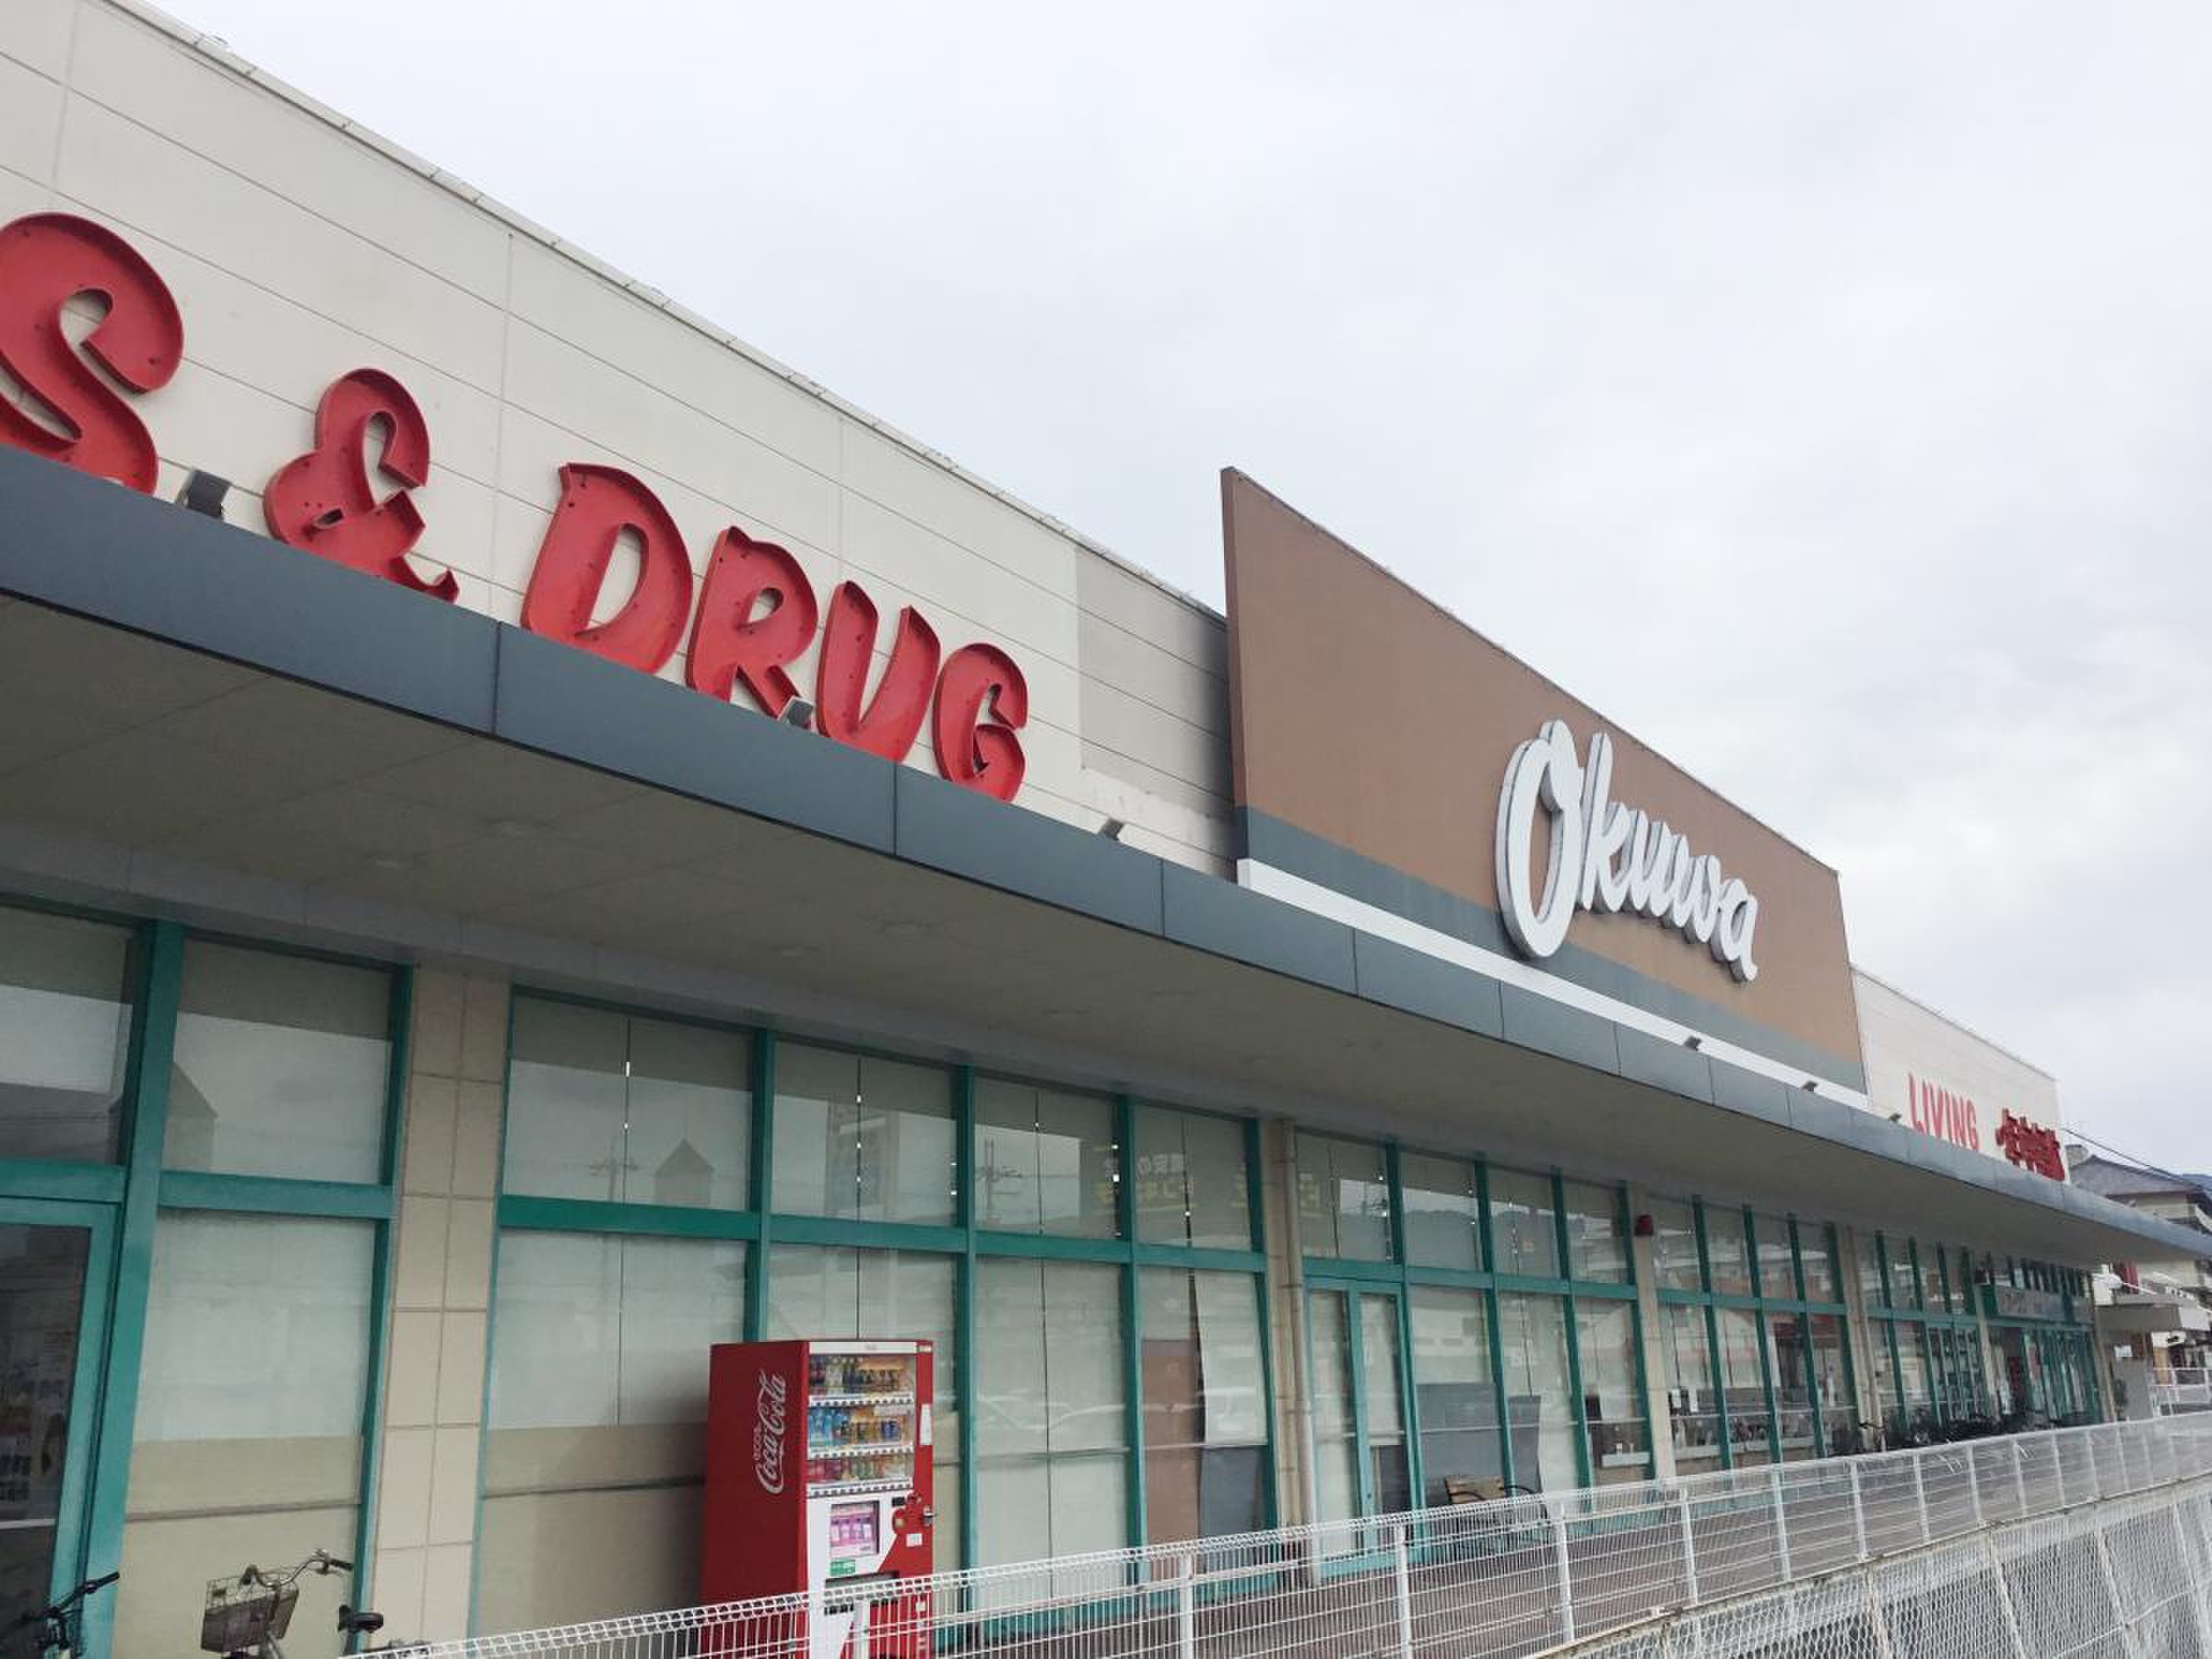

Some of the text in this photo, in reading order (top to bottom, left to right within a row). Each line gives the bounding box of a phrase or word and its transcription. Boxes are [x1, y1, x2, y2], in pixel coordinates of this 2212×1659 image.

[264, 369, 459, 603] &
[520, 463, 1029, 803] DRUG
[1495, 719, 1759, 982] Okuwa
[1907, 1073, 1980, 1151] LIVING
